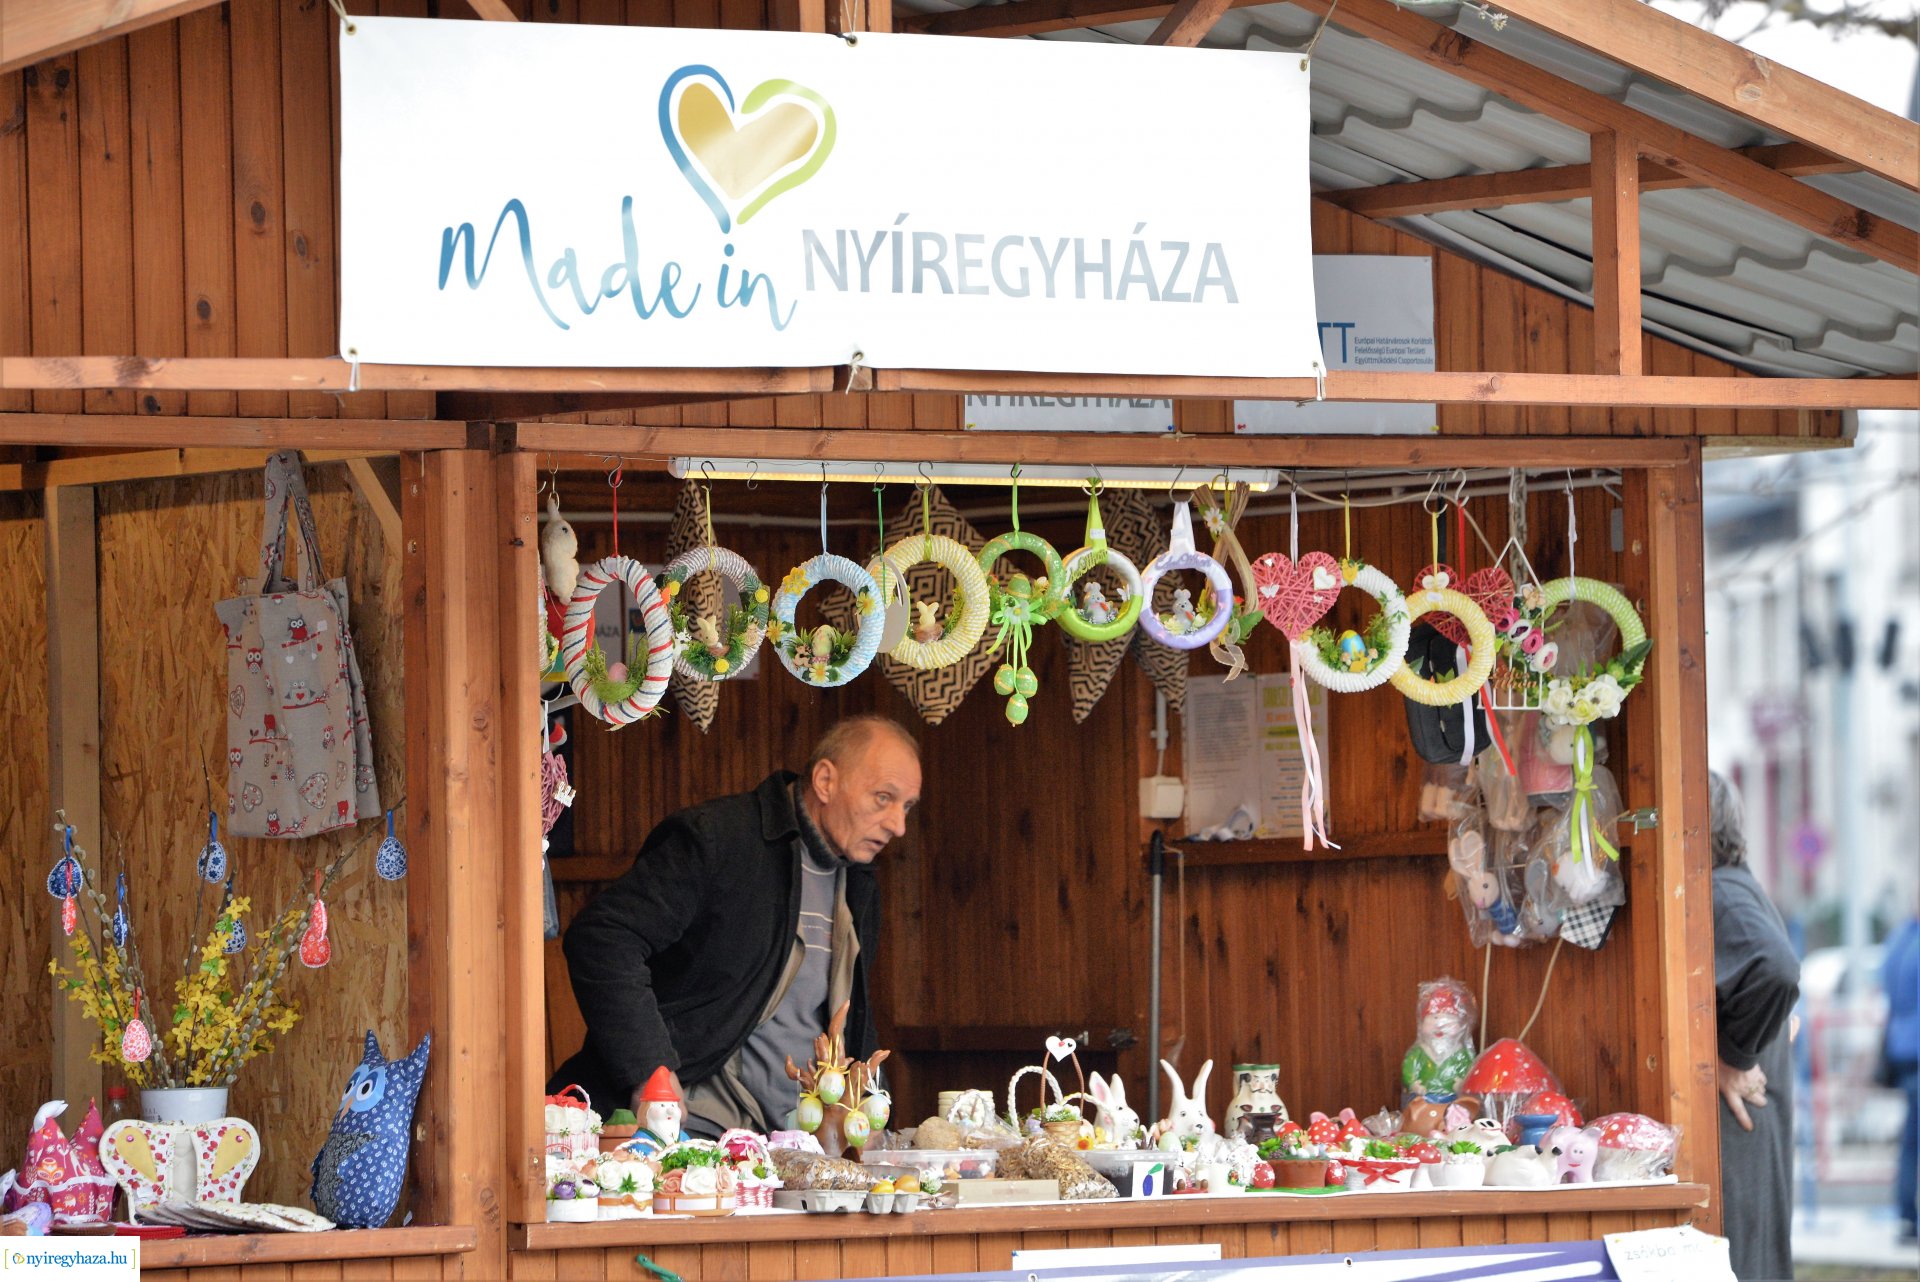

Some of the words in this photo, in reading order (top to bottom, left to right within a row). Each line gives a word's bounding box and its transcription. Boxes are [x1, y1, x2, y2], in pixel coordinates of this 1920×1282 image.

[437, 195, 701, 331] Made
[717, 243, 798, 332] in
[802, 212, 1240, 304] NYÍREGYHÁZA
